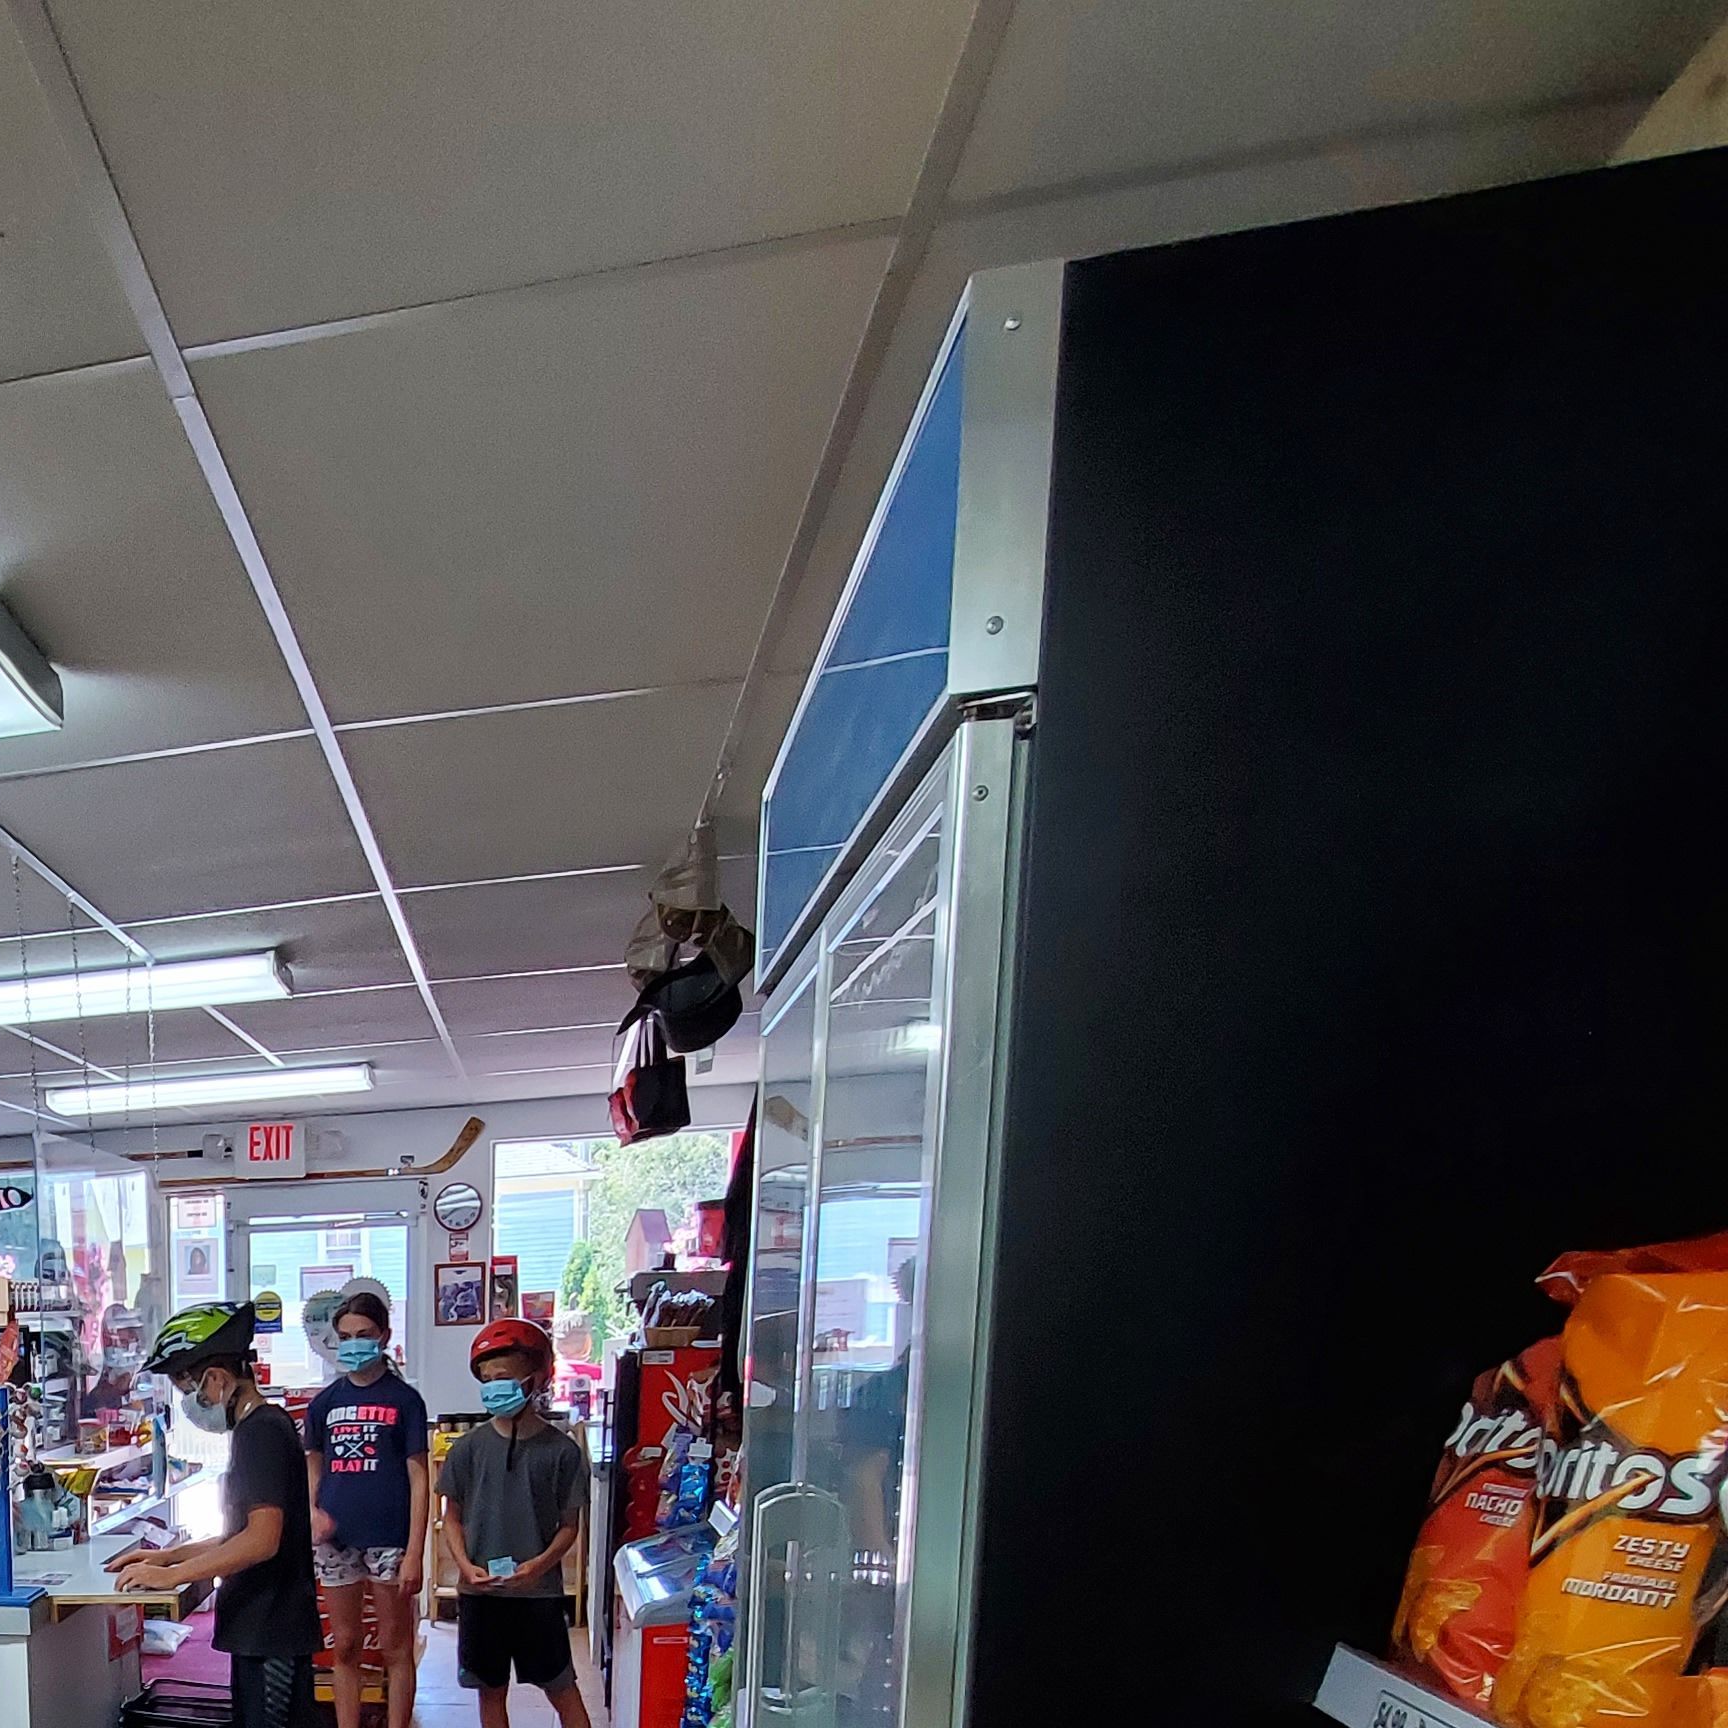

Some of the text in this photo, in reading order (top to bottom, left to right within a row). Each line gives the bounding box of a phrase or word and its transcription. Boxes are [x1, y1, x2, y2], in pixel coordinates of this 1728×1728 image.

[248, 1124, 294, 1162] EXIT
[330, 1433, 379, 1444] LOVE IT
[362, 1425, 377, 1433] IT
[330, 1458, 379, 1473] PLAY IT
[1465, 1492, 1523, 1516] NACHO
[1613, 1534, 1691, 1559] ZESTY
[1624, 1554, 1685, 1573] CHEESE
[1601, 1570, 1679, 1591] FROMAGE
[1561, 1577, 1677, 1610] MORDANT
